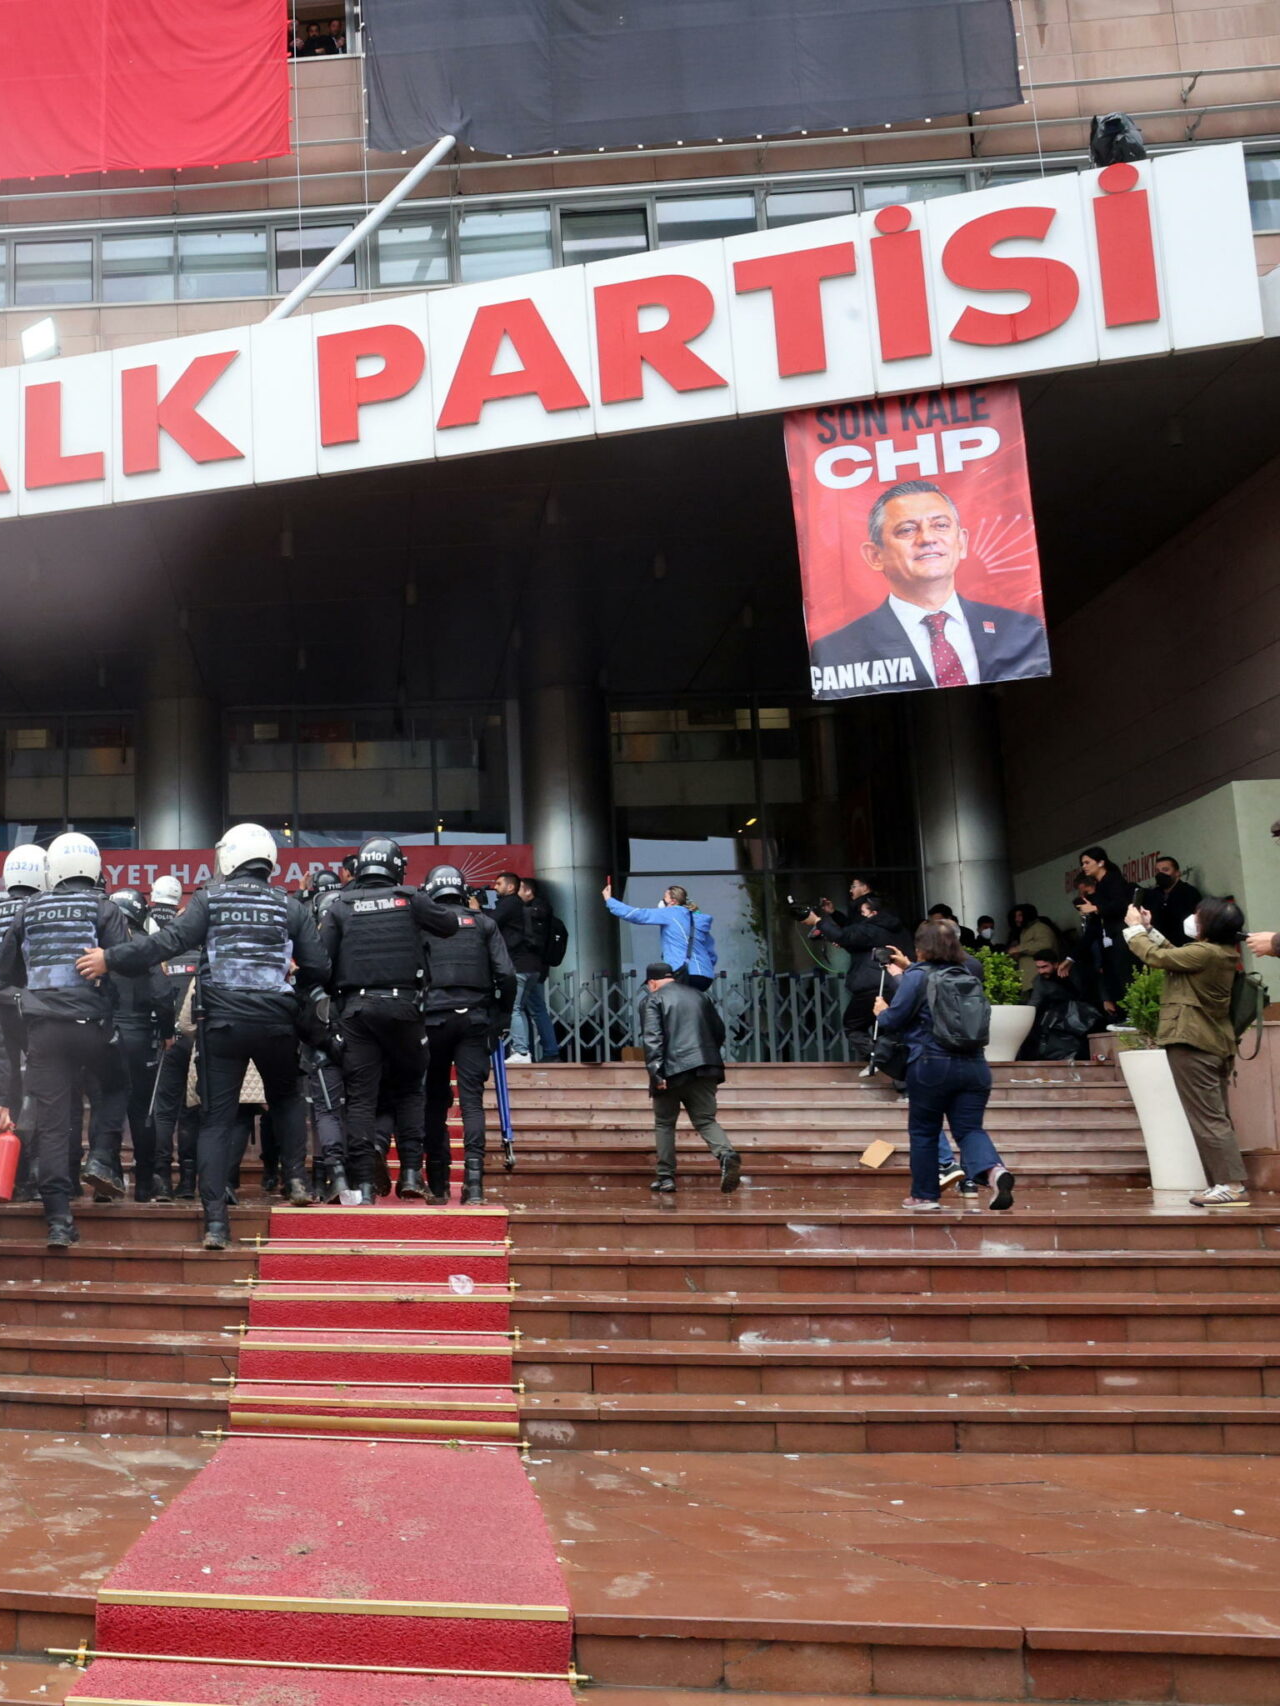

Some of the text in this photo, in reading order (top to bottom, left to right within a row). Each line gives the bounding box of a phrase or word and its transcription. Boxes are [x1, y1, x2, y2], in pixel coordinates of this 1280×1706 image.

[317, 162, 1160, 446] PARTİSİ
[816, 384, 991, 445] SON KALE
[813, 426, 1002, 490] CHP
[37, 906, 83, 921] POLİS
[220, 910, 270, 923] POLİS
